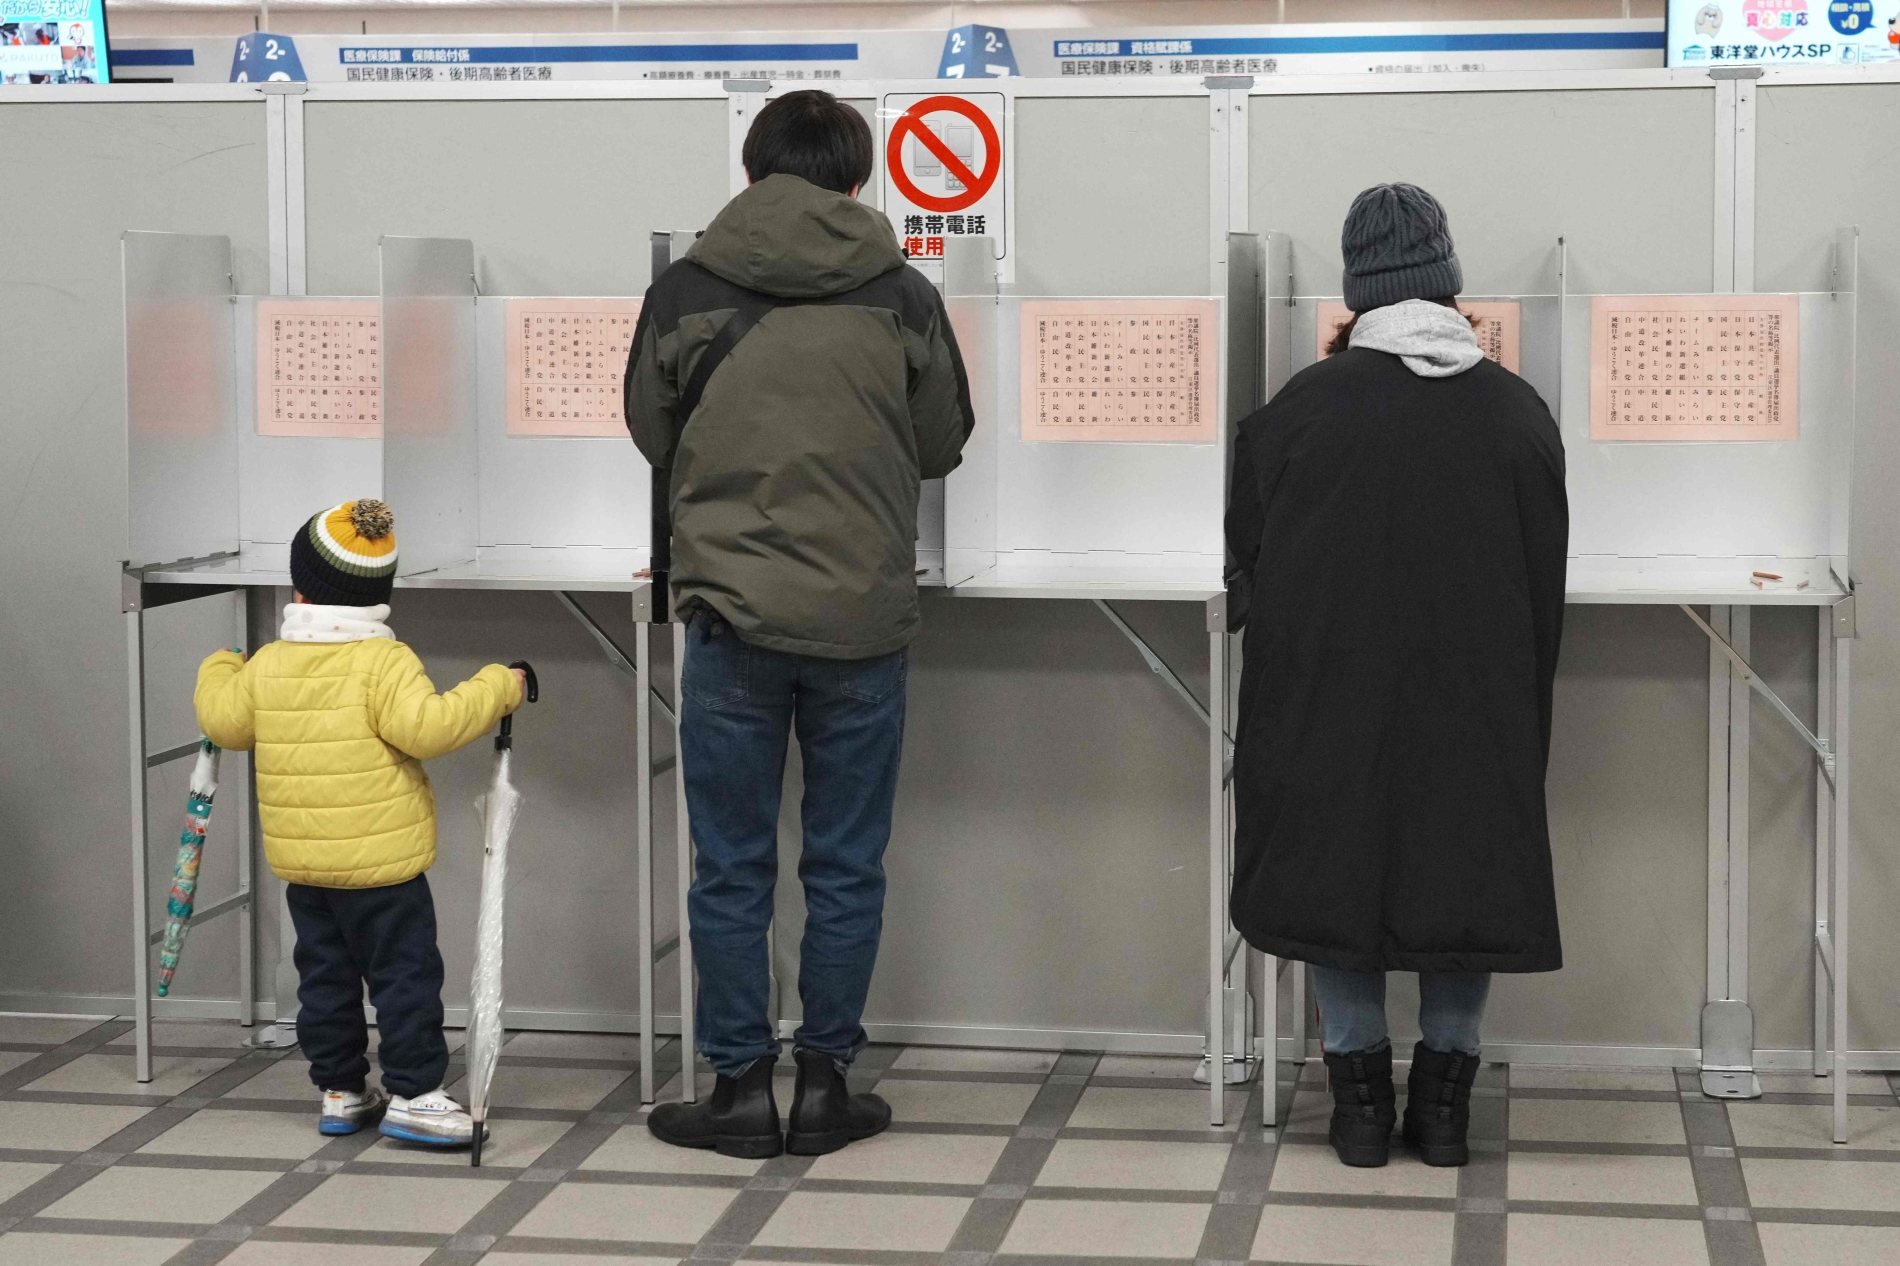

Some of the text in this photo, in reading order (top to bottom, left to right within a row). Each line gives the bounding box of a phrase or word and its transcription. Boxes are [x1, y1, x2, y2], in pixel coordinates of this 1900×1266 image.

[1710, 44, 1831, 59] 東洋堂ハウスSP
[904, 215, 986, 235] 携帯電話
[904, 236, 943, 256] 使用
[1129, 320, 1137, 383] 参政党
[1142, 320, 1150, 383] 国民民主党
[1155, 320, 1163, 383] 日本保守党
[1624, 316, 1632, 381] 自由民主党
[1665, 316, 1673, 381] 日本維新の会
[1679, 317, 1687, 381] れいわ新選組
[1720, 316, 1728, 381] 国民民主党
[1734, 316, 1742, 381] 日本保守党
[298, 389, 305, 419] 中道
[322, 389, 329, 419] 維新
[358, 390, 365, 420] 参政
[548, 387, 555, 418] 中道
[573, 387, 580, 418] 維新
[1052, 391, 1060, 423] 自民党
[1065, 391, 1072, 423] 中道
[1078, 391, 1086, 423] 社民党
[1091, 391, 1098, 423] 維新
[1130, 391, 1137, 423] 参政
[1169, 391, 1177, 423] 共産党
[1638, 389, 1645, 422] 中道
[1651, 389, 1659, 422] 社民党
[1665, 389, 1672, 422] 維新
[1706, 389, 1714, 422] 参政
